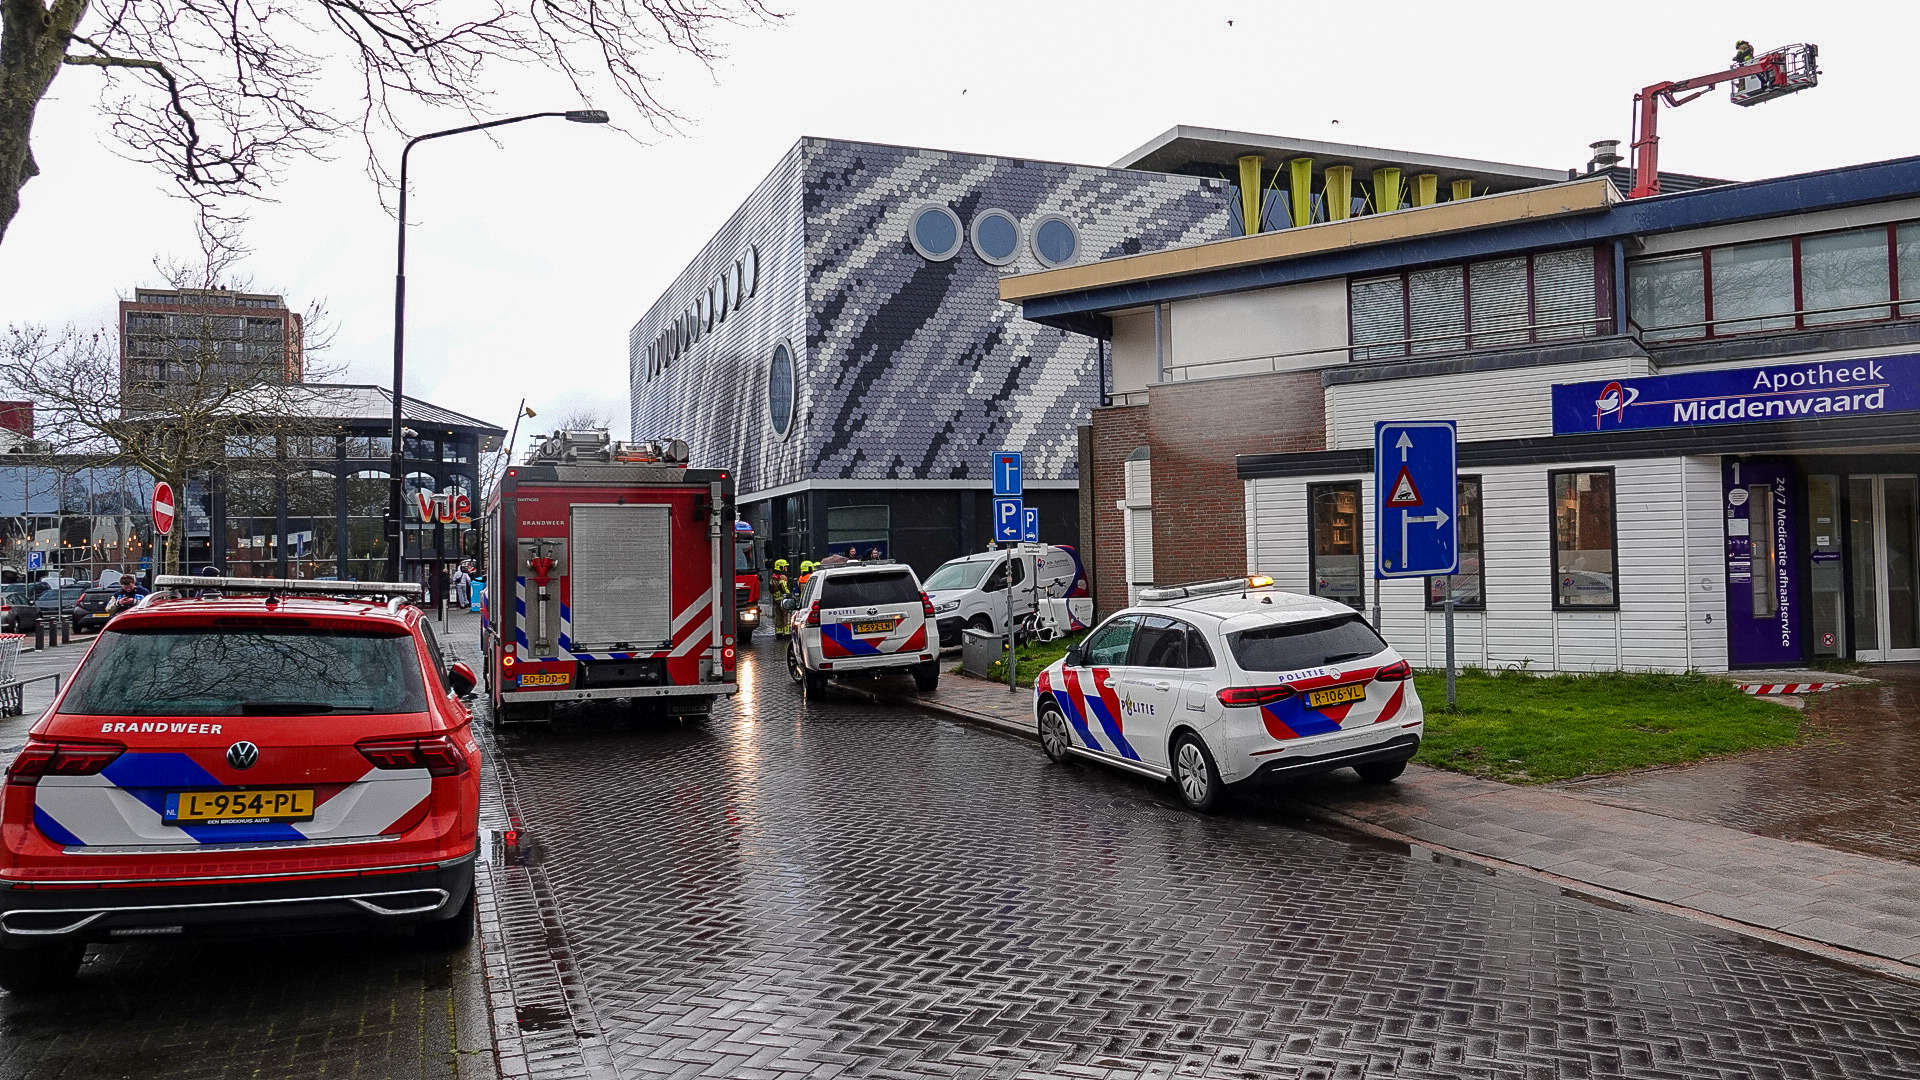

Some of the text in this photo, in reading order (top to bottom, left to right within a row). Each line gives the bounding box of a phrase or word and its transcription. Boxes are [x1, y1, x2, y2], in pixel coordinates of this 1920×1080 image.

[1753, 360, 1884, 391] Apotheek
[1673, 388, 1885, 422] Middenwaard
[1731, 462, 1740, 485] 1
[1001, 502, 1017, 524] P
[1026, 511, 1035, 528] P
[31, 553, 39, 562] P
[1774, 477, 1791, 647] 24/7 Medicatie afhaalservice
[522, 674, 568, 684] 50-BDD-9
[1278, 668, 1326, 683] POLITIE
[1313, 685, 1361, 705] R-106-VL
[1121, 699, 1155, 717] POLITIE
[101, 722, 223, 735] BRANDWEER
[166, 793, 304, 816] NL L-954-PL
